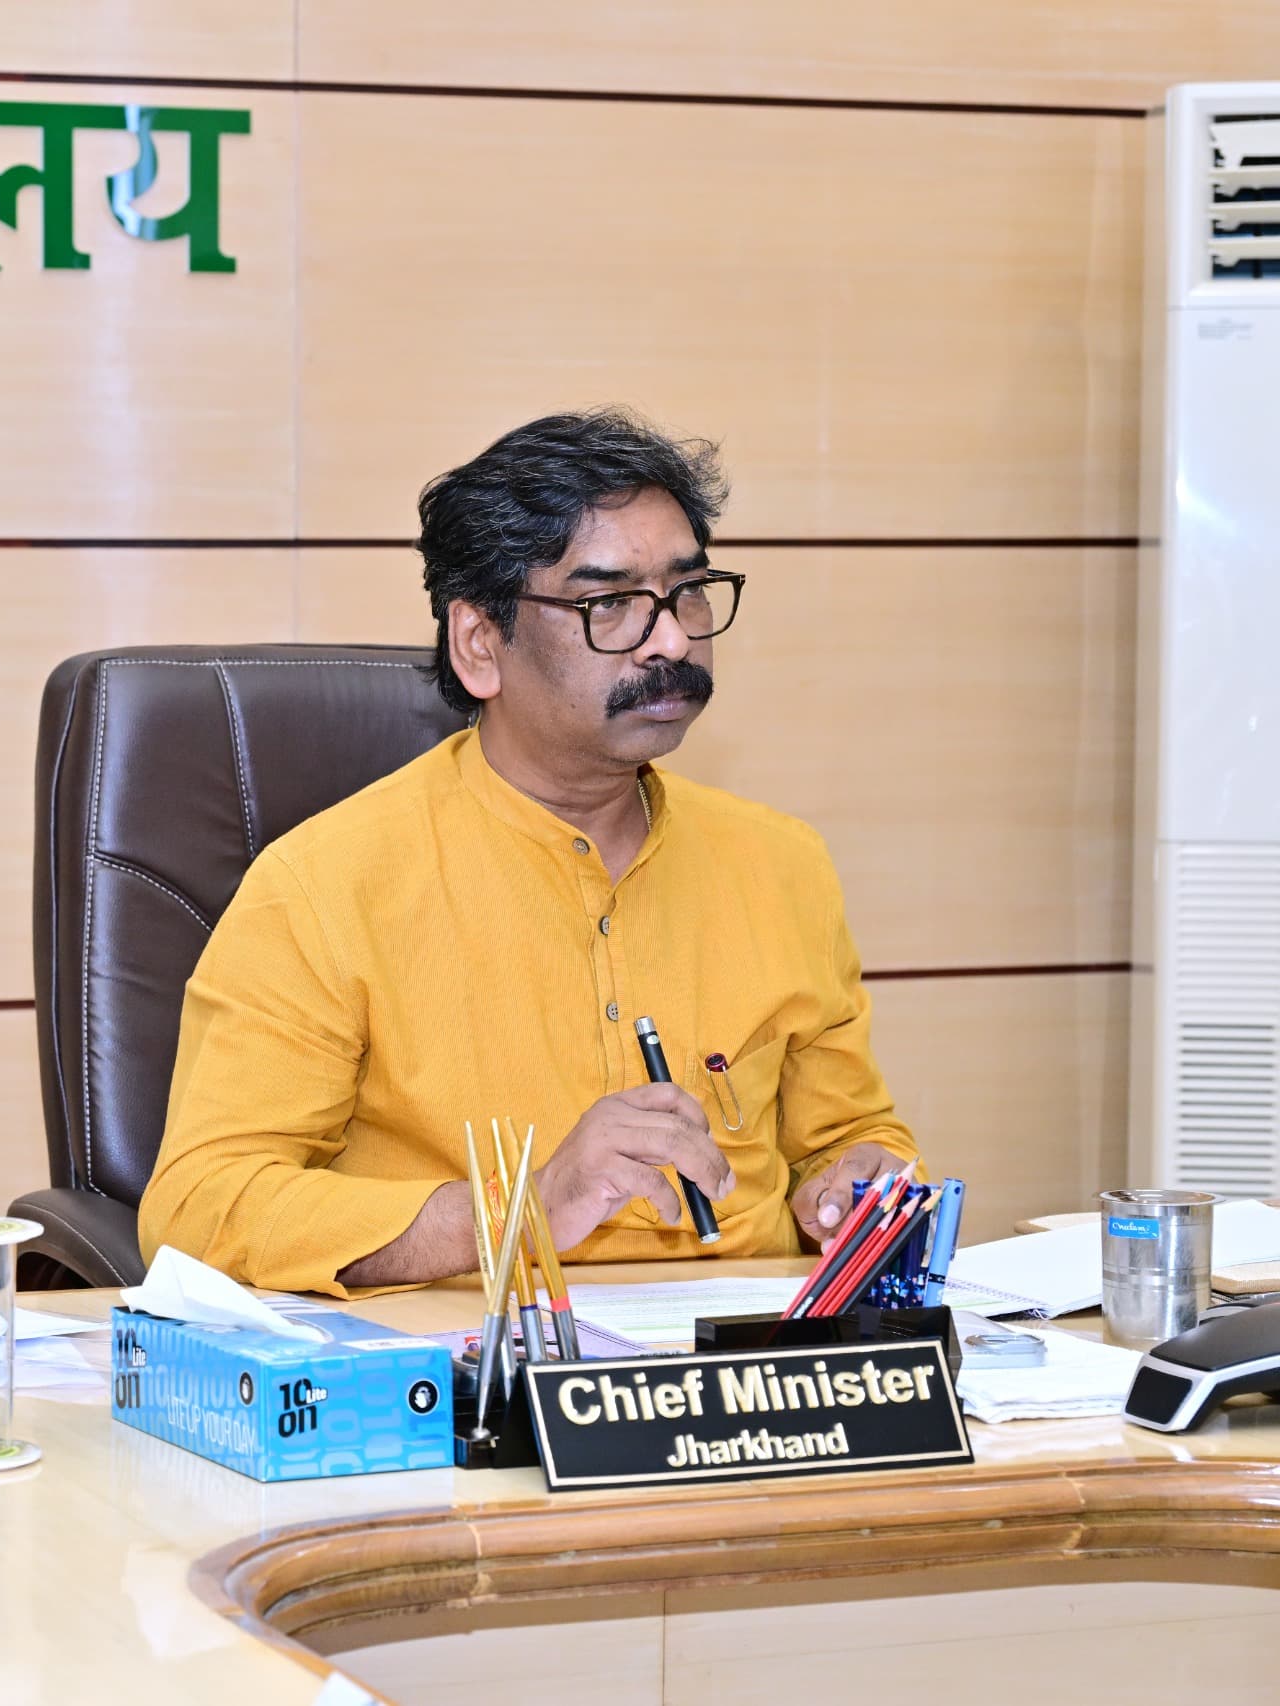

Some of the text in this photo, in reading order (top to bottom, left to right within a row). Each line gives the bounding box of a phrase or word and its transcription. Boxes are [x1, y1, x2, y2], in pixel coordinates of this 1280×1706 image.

[279, 1378, 328, 1411] 10 Lite
[558, 1359, 935, 1426] Chief Minister
[666, 1422, 849, 1468] Jharkhand
